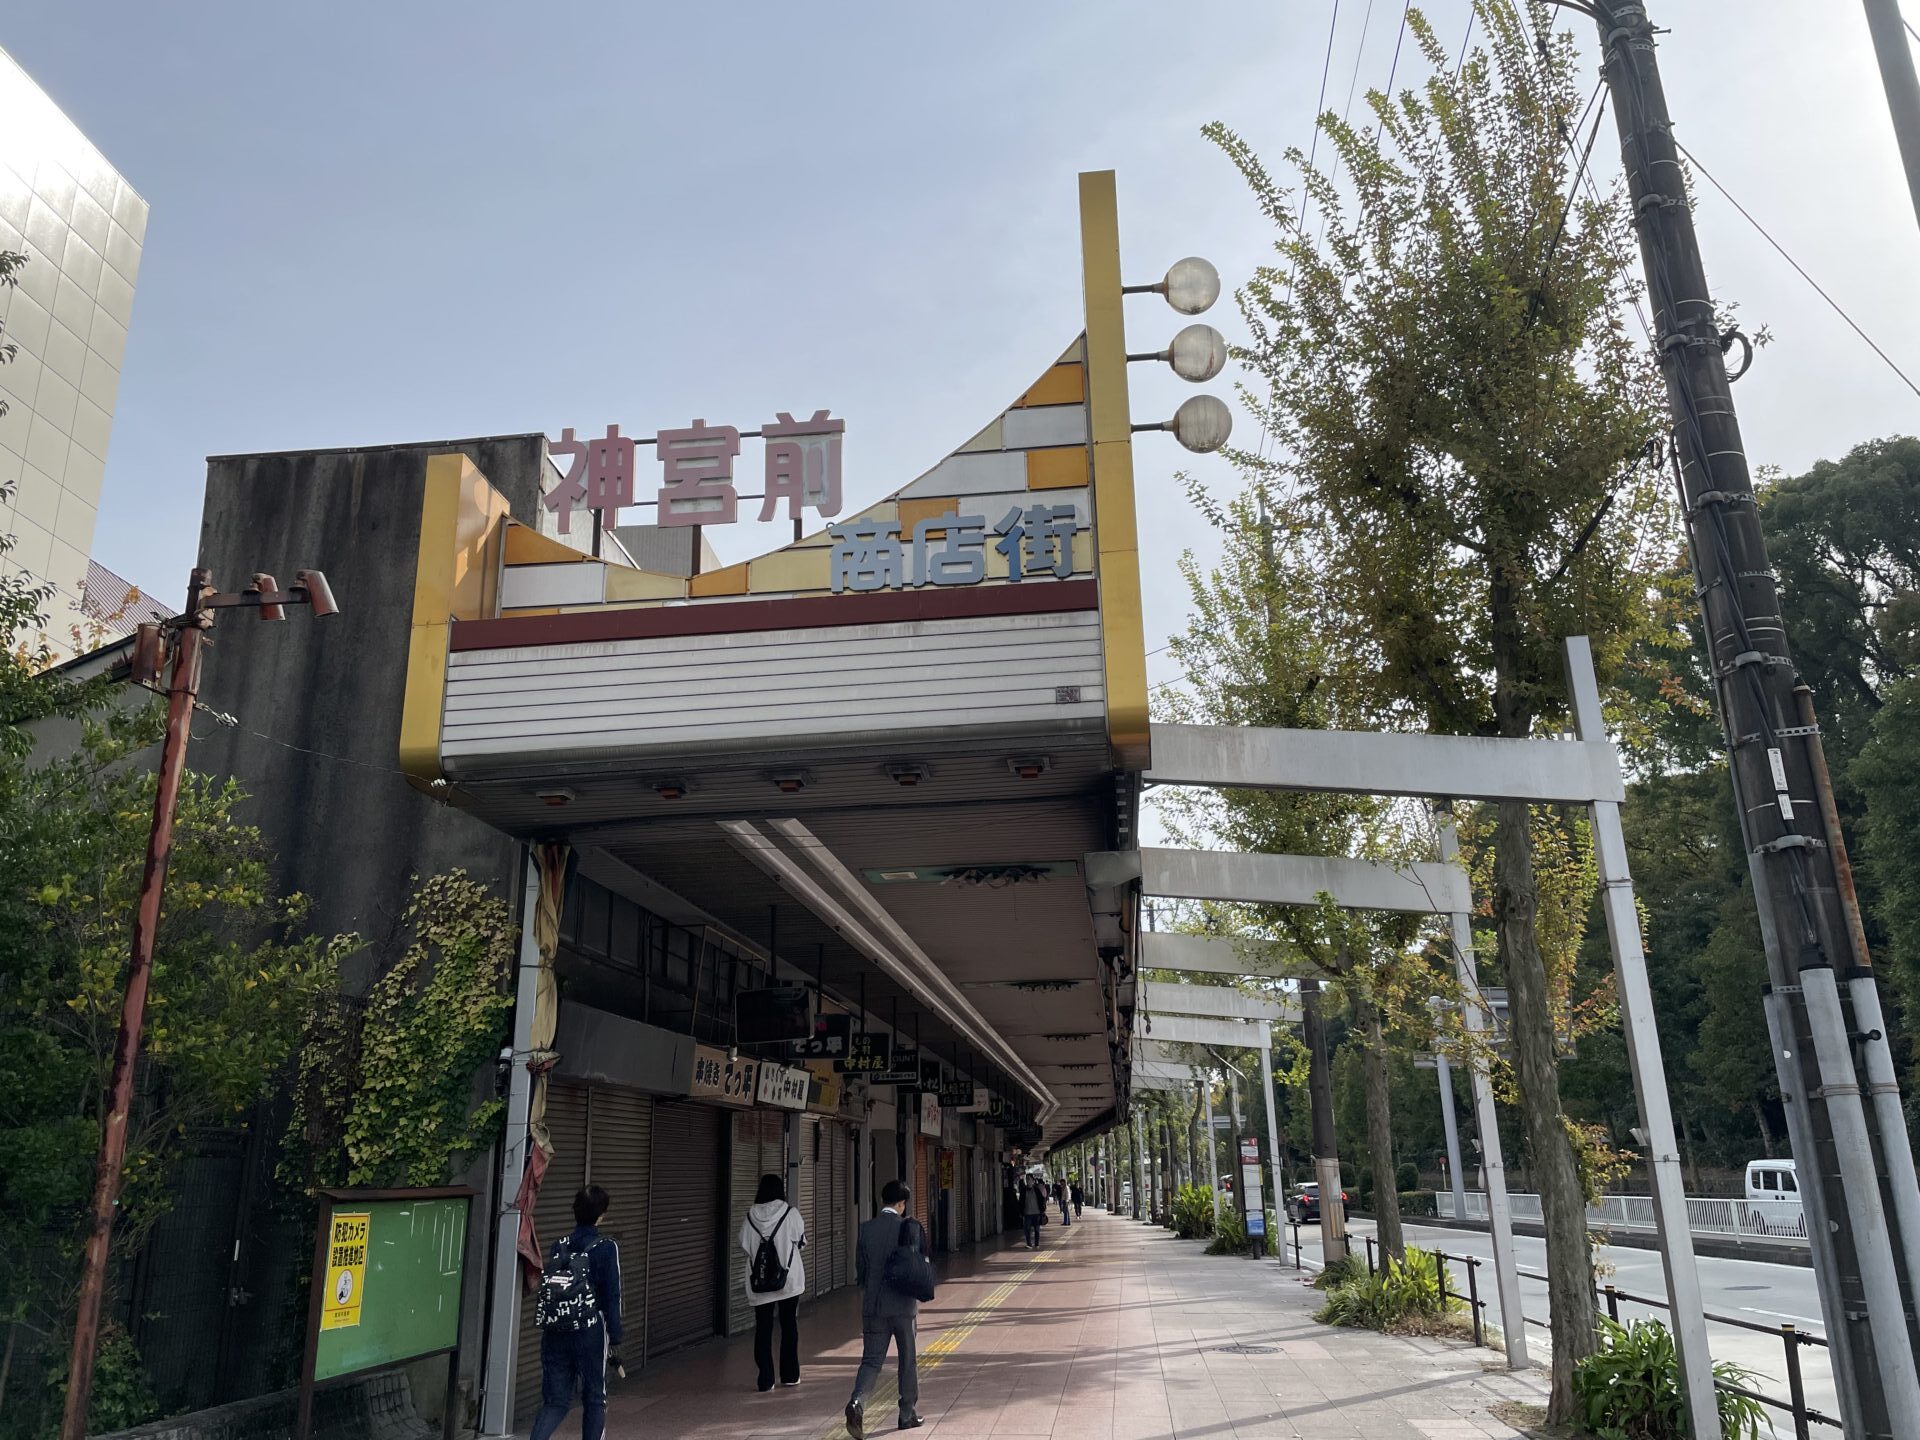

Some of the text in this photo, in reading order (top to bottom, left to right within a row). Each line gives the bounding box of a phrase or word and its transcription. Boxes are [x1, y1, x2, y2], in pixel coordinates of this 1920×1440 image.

[543, 409, 846, 534] 神宮前
[829, 504, 1078, 594] 商店街
[695, 1057, 720, 1087] 串焼き
[844, 1056, 884, 1071] 中村屋
[783, 1076, 805, 1101] 中村屋
[334, 1222, 366, 1243] 防犯カメラ
